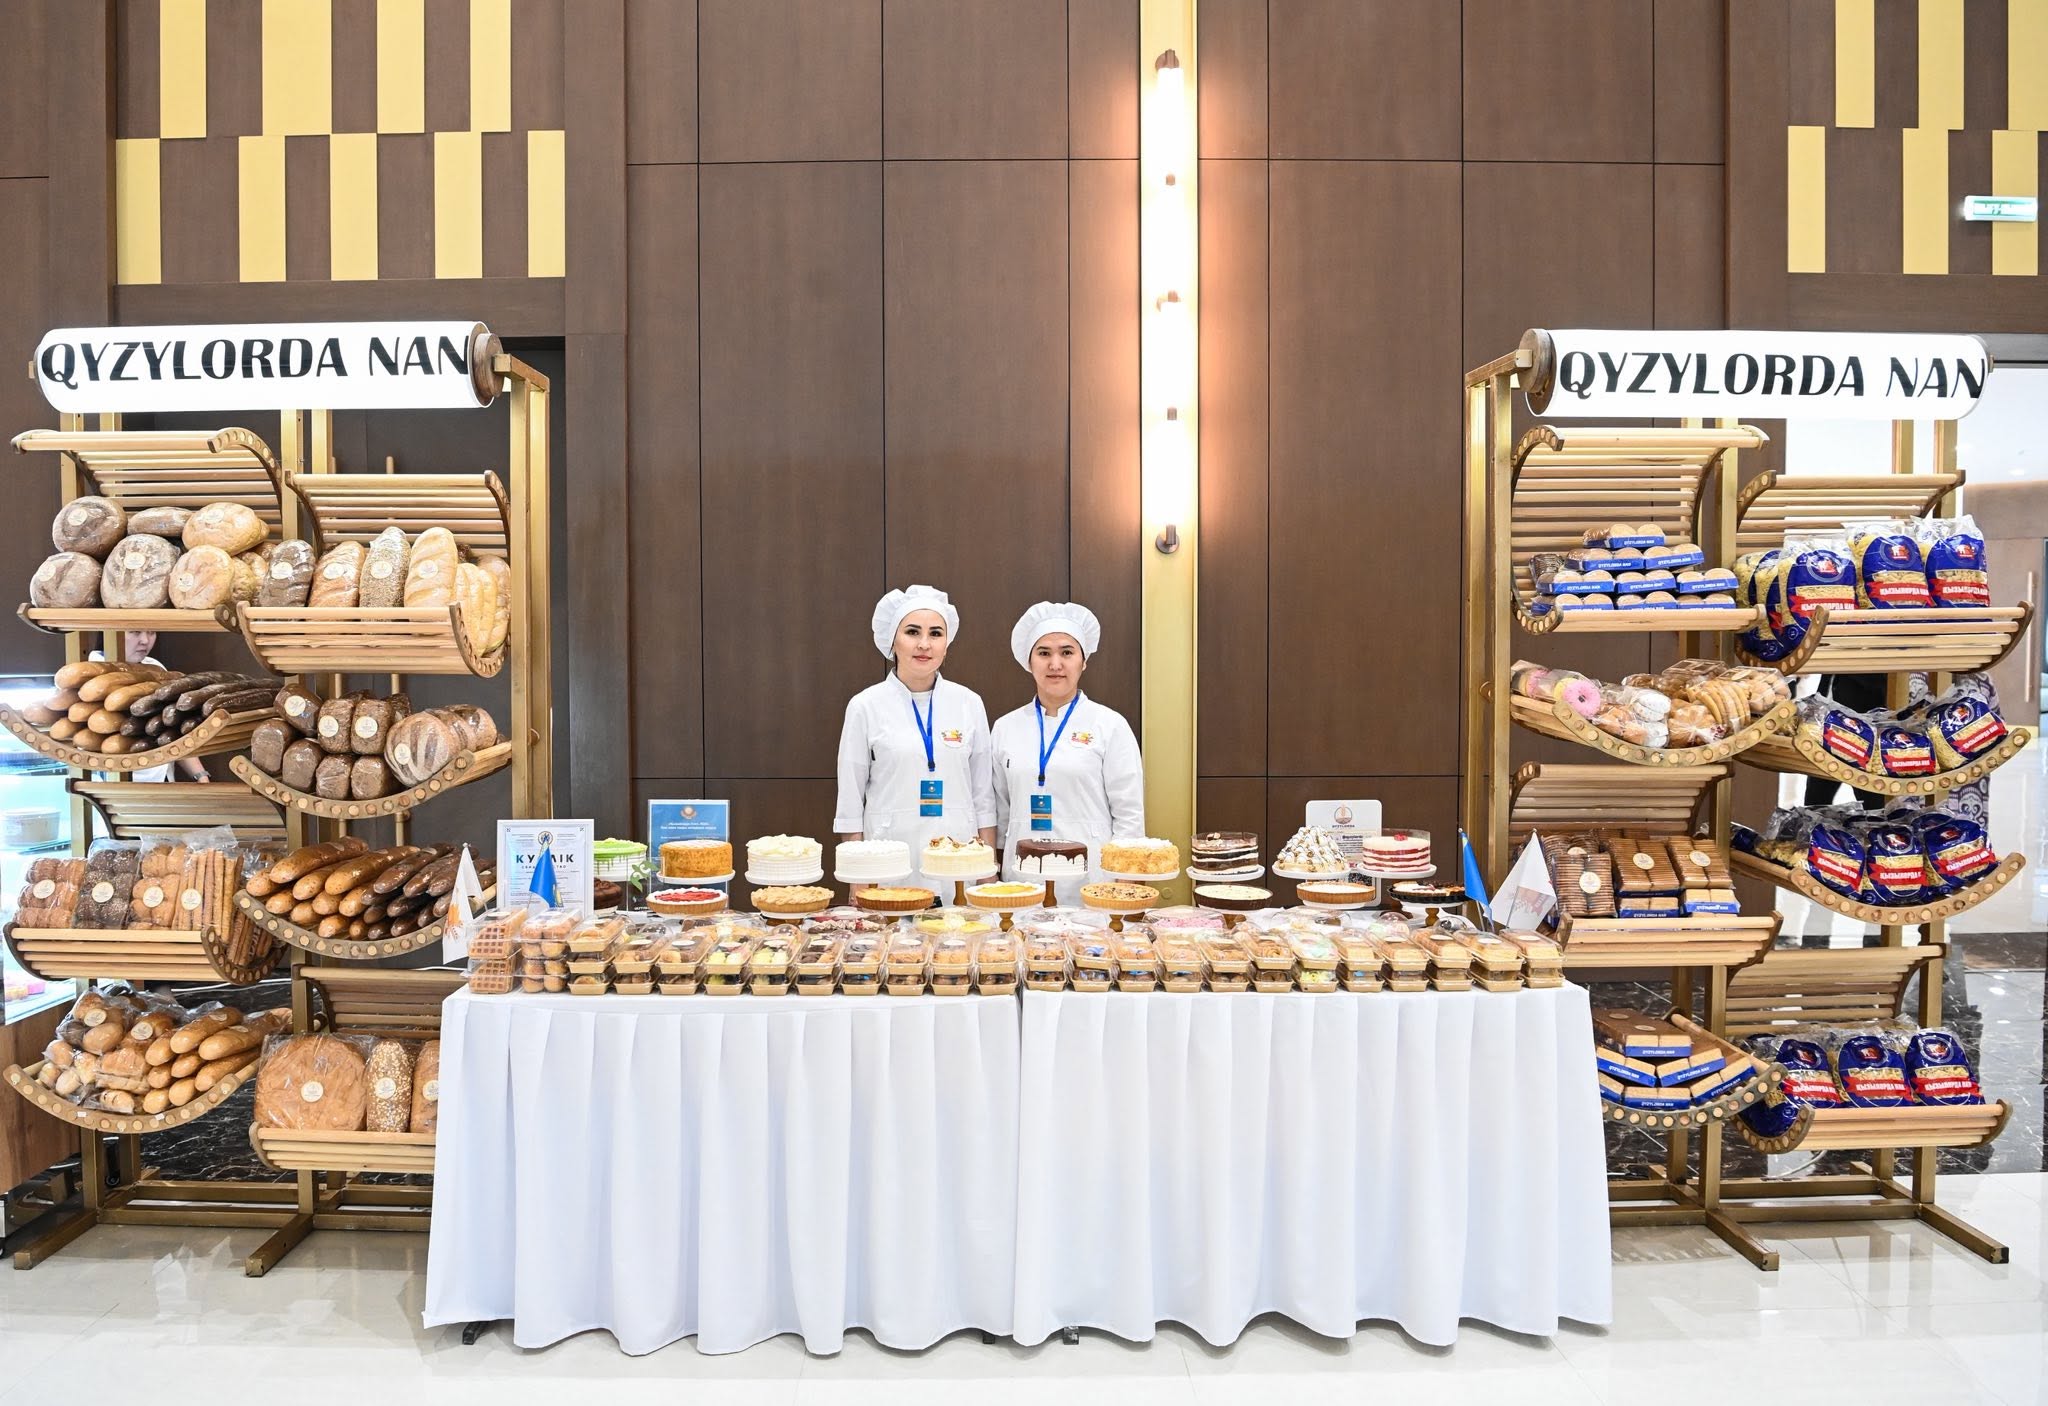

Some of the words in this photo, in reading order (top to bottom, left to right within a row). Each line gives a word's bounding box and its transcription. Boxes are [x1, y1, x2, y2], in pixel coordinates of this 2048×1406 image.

[41, 338, 348, 390] QYZYLORDA
[368, 335, 469, 376] NAN
[1559, 351, 1866, 399] QYZYLORDA
[1885, 356, 1985, 398] NAN
[516, 854, 574, 864] КУЛІК
